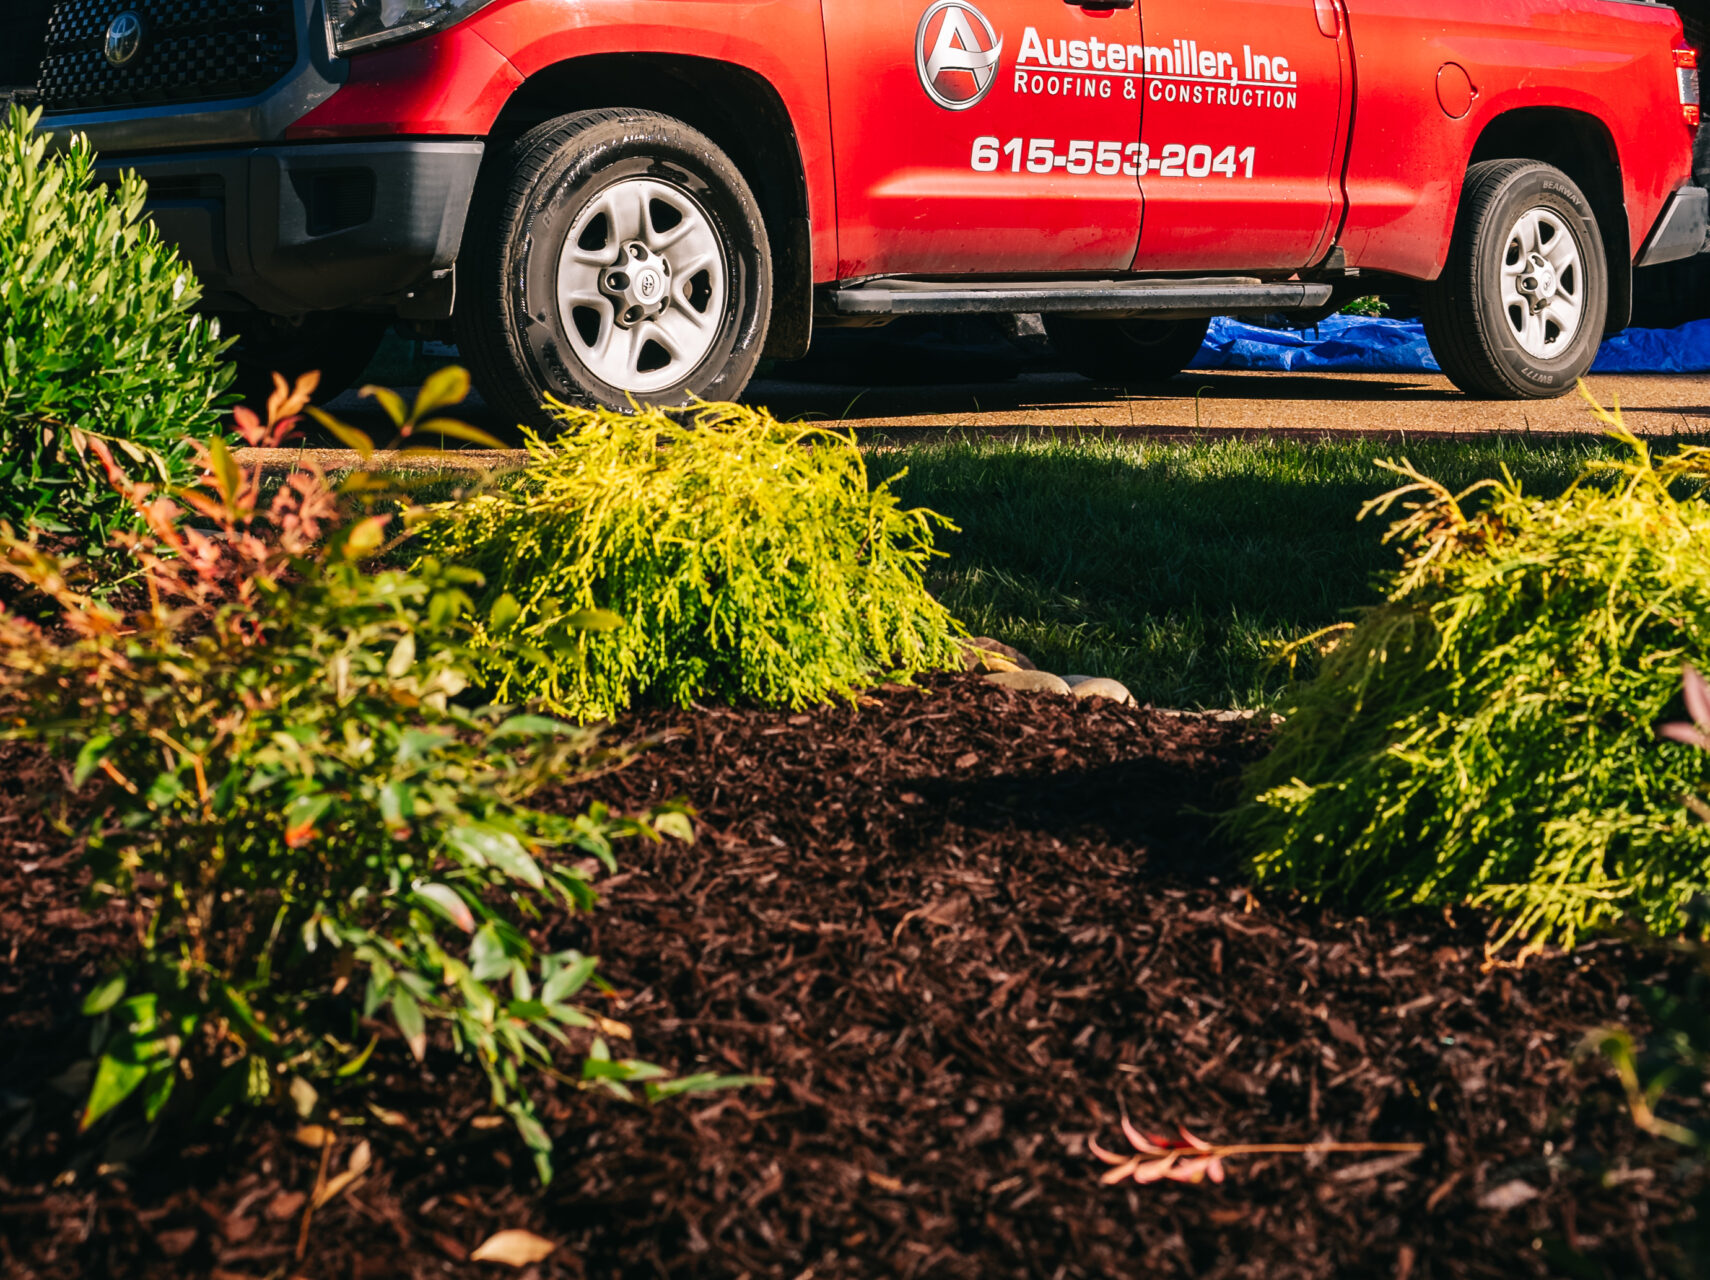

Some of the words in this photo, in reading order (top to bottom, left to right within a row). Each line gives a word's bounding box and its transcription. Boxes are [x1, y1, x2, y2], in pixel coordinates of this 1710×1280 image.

[926, 7, 1003, 91] A
[1016, 26, 1238, 87] Austermiller,
[1244, 44, 1297, 83] Inc.
[1013, 71, 1111, 98] ROOFING
[1123, 78, 1136, 100] &
[1149, 79, 1297, 109] CONSTRUCTION
[970, 136, 1257, 180] 615-553-2041
[1543, 180, 1582, 206] BEARWAY
